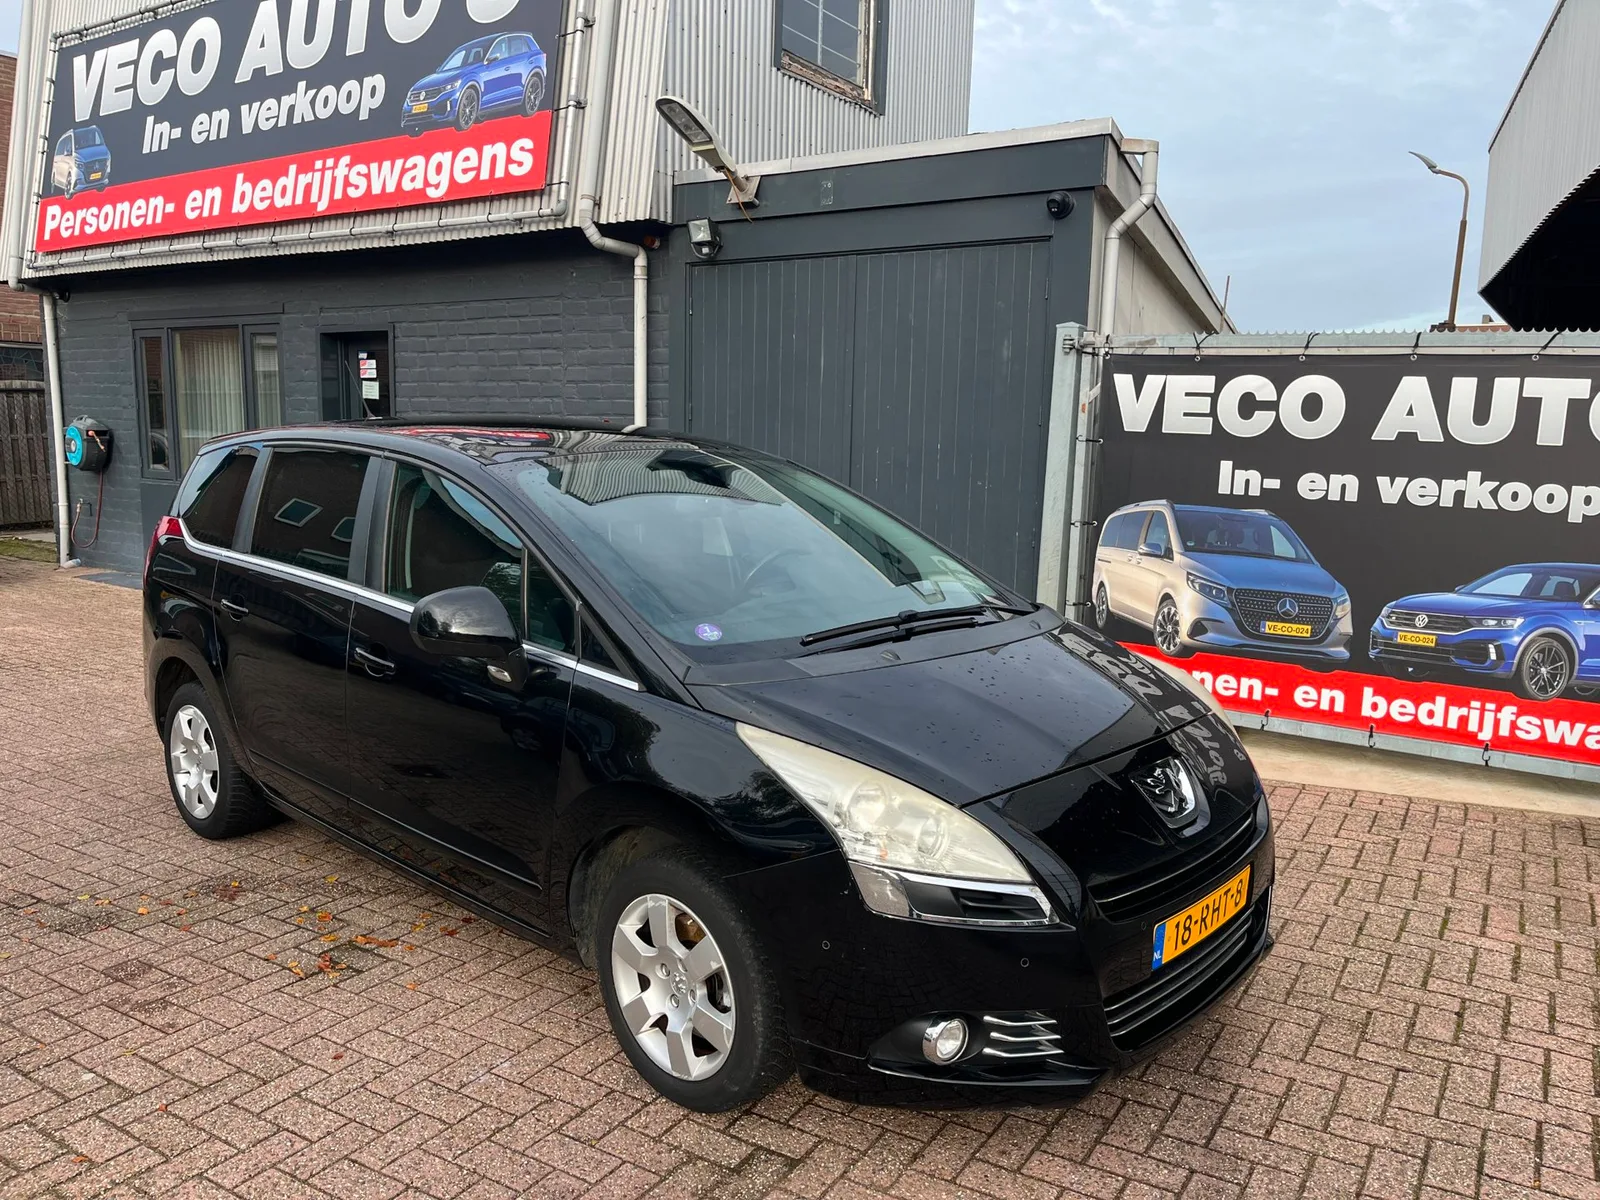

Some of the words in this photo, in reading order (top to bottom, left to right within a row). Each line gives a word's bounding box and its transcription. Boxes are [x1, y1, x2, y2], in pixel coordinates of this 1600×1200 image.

[73, 16, 222, 122] VECO
[142, 115, 182, 154] In-
[191, 108, 230, 144] en
[241, 73, 386, 135] verkoop
[43, 197, 175, 241] Personen-
[185, 184, 220, 219] en
[231, 138, 534, 214] bedrijfswagens
[1113, 373, 1346, 440] VECO
[1217, 460, 1281, 497] In-
[1297, 471, 1359, 502] en
[1376, 471, 1600, 524] verkoop
[1266, 624, 1310, 636] VE-CO-024
[1398, 633, 1435, 645] VE-CO-024
[1293, 684, 1345, 713] en
[1153, 949, 1161, 961] NL
[1174, 878, 1243, 951] 18-RHT-8
